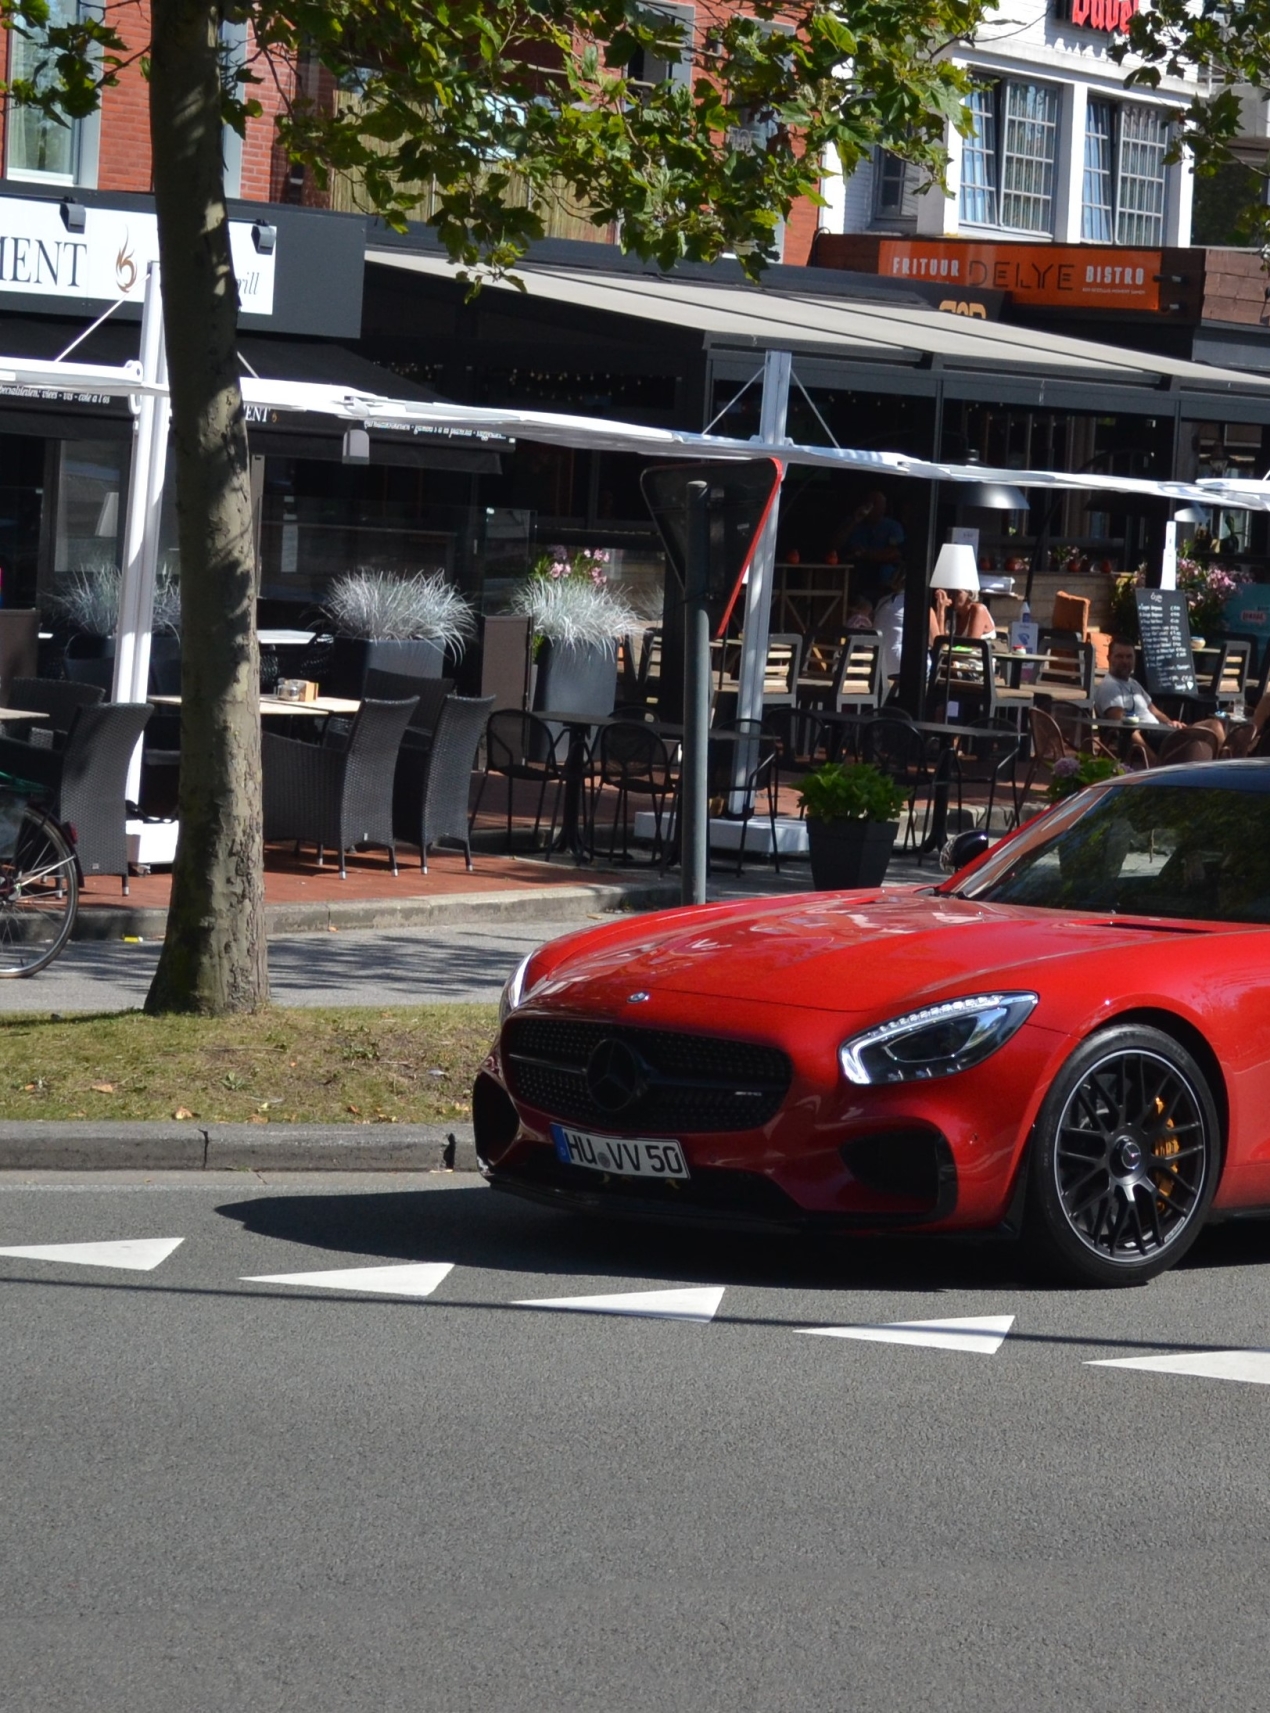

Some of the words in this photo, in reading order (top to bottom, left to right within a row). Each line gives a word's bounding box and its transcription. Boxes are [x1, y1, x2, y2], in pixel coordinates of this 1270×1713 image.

[0, 236, 87, 289] ENT
[892, 256, 960, 277] FRITUUR
[969, 260, 1075, 291] DELYE
[1085, 264, 1145, 286] BISTRO
[243, 404, 271, 423] ENT
[564, 1132, 598, 1166] HU
[606, 1141, 641, 1172] VV
[644, 1145, 683, 1174] 50
